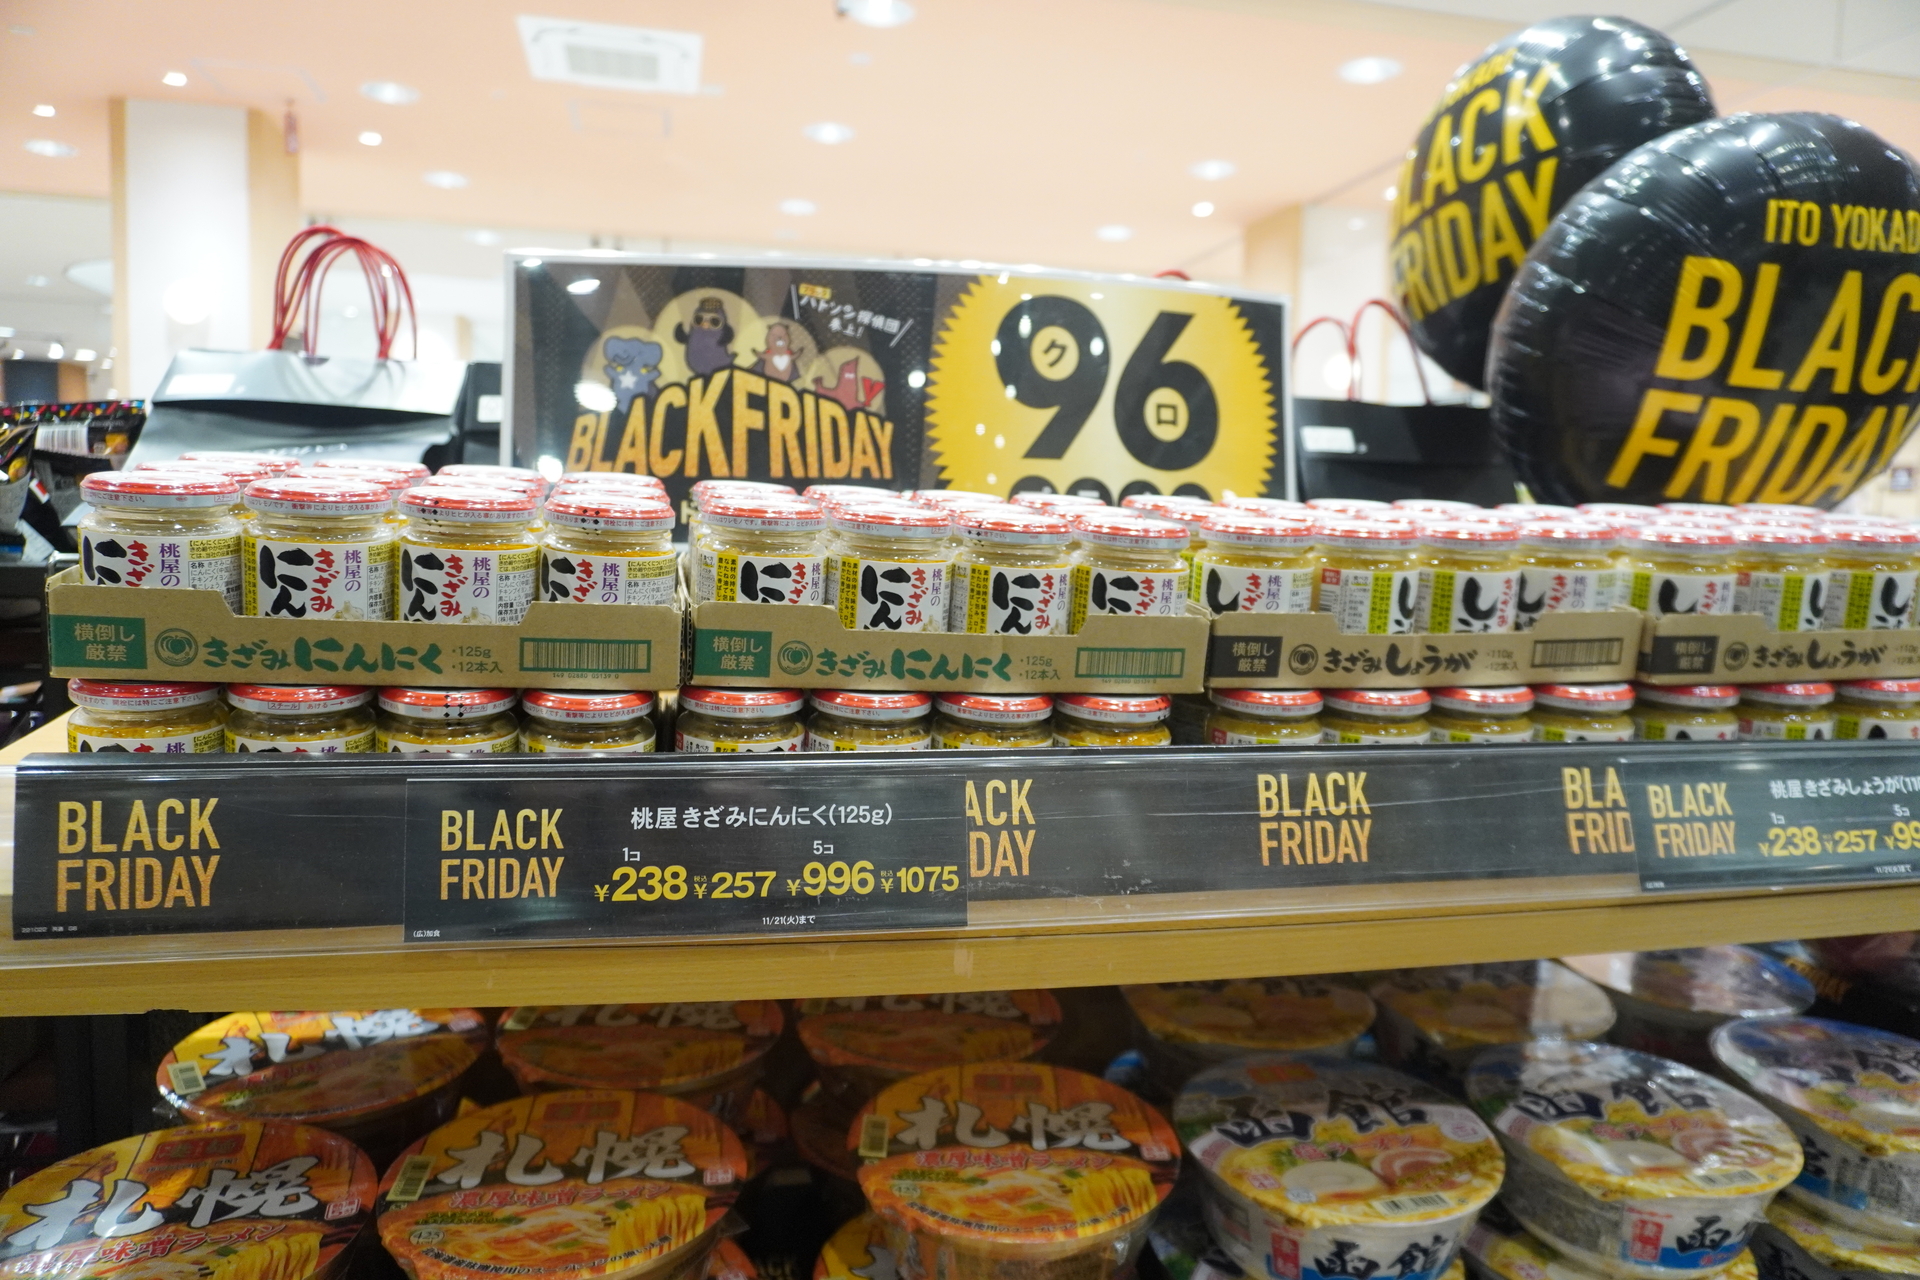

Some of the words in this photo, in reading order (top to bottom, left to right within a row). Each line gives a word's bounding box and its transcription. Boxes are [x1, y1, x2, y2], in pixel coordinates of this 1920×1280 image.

[1391, 62, 1561, 243] LACK
[1764, 198, 1821, 247] ITO
[1654, 255, 1920, 395] BLAC
[1043, 338, 1068, 368] ク
[994, 294, 1220, 472] 96
[83, 536, 127, 585] に
[159, 543, 181, 587] 桃屋の
[310, 548, 340, 612] きざみ
[344, 549, 362, 592] 桃屋の
[472, 557, 491, 598] 桃屋の
[541, 553, 576, 601] に
[260, 545, 314, 618] にん
[401, 549, 444, 621] にん
[439, 554, 469, 617] きざみ
[601, 563, 620, 603] 桃屋の
[740, 561, 793, 603] に
[810, 562, 821, 601] 桃屋の
[861, 565, 911, 630] にん
[905, 567, 929, 626] きざみ
[931, 568, 943, 606] 桃屋の
[1034, 573, 1055, 629] きざみ
[1056, 574, 1067, 611] 桃屋の
[1092, 572, 1140, 614] に
[1159, 578, 1175, 615] 桃屋の
[1266, 575, 1282, 611] 桃屋の
[992, 571, 1041, 634] にん
[74, 623, 135, 642] 横倒し
[86, 644, 127, 661] 厳禁
[713, 637, 763, 653] 横倒し
[1232, 642, 1274, 657] 横倒し
[202, 636, 443, 674] きざみにんにく
[721, 655, 755, 670] 厳禁
[816, 648, 1012, 682] きざみにんにく
[1238, 658, 1267, 673] 厳禁
[1323, 643, 1479, 677] きざみしょうが
[1752, 639, 1887, 671] きざみしょうが
[269, 701, 298, 710] スチール
[306, 702, 327, 710] あける
[462, 705, 486, 714] スチール
[1257, 771, 1371, 818] BLACK
[1647, 782, 1733, 819] BLACK
[1769, 779, 1803, 799] 桃屋
[58, 798, 220, 854] BLACK
[441, 808, 564, 851] BLACK
[631, 807, 678, 830] 桃屋
[682, 803, 893, 828] きざみにんにく(125g)
[1770, 812, 1785, 825] 1コ
[1893, 804, 1910, 817] 5コ
[622, 847, 641, 862] 1コ
[813, 841, 834, 855] 5コ
[1260, 819, 1372, 866] FRIDAY
[1654, 821, 1736, 858] FRIDAY
[1759, 826, 1822, 858] ¥238
[1824, 829, 1878, 854] ¥257
[56, 855, 220, 912] FRIDAY
[440, 857, 564, 900] FRIDAY
[594, 865, 688, 902] ¥238
[694, 871, 777, 899] ¥257
[787, 860, 875, 896] ¥996
[881, 866, 960, 894] ¥1075
[762, 914, 816, 926] 11/21(火)まで
[896, 1095, 1132, 1151] 札幌
[437, 1126, 697, 1189] 札幌
[915, 1150, 1114, 1171] 濃厚味噌ラーメン
[6, 1155, 321, 1251] 札幌
[449, 1184, 672, 1210] 濃厚味噌ラーメン
